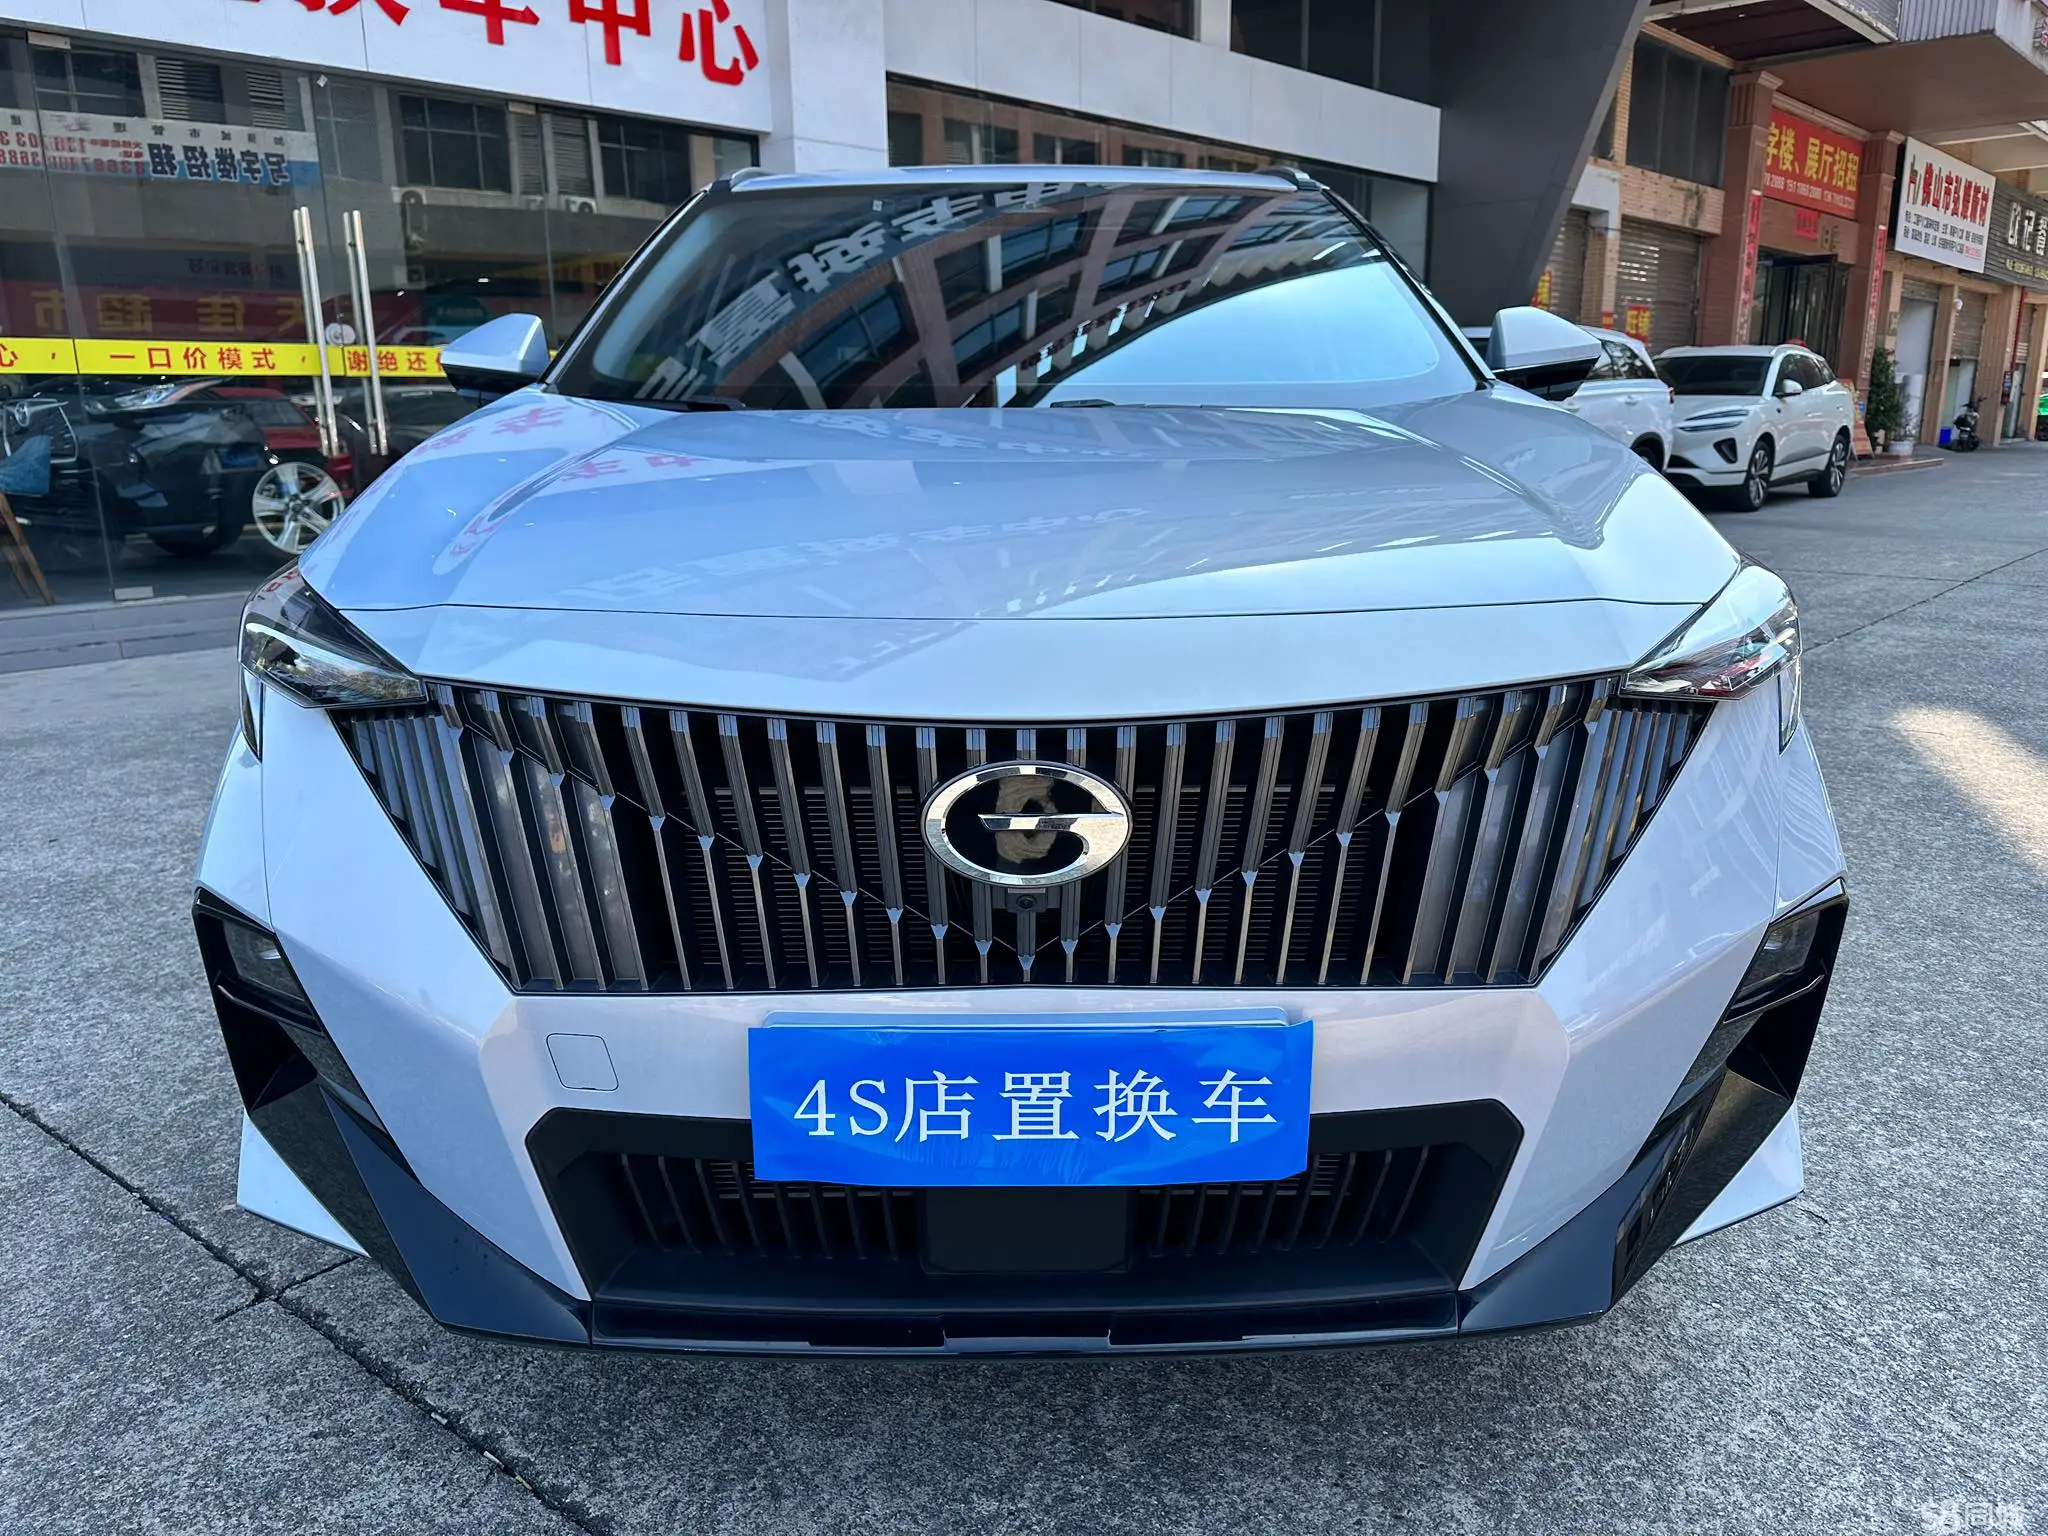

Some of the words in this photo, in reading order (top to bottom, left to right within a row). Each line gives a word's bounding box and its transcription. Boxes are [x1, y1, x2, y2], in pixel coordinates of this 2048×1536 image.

[110, 347, 276, 370] 一口价模式
[347, 351, 444, 376] 谢绝还
[793, 1068, 1278, 1143] 4S店置换车
